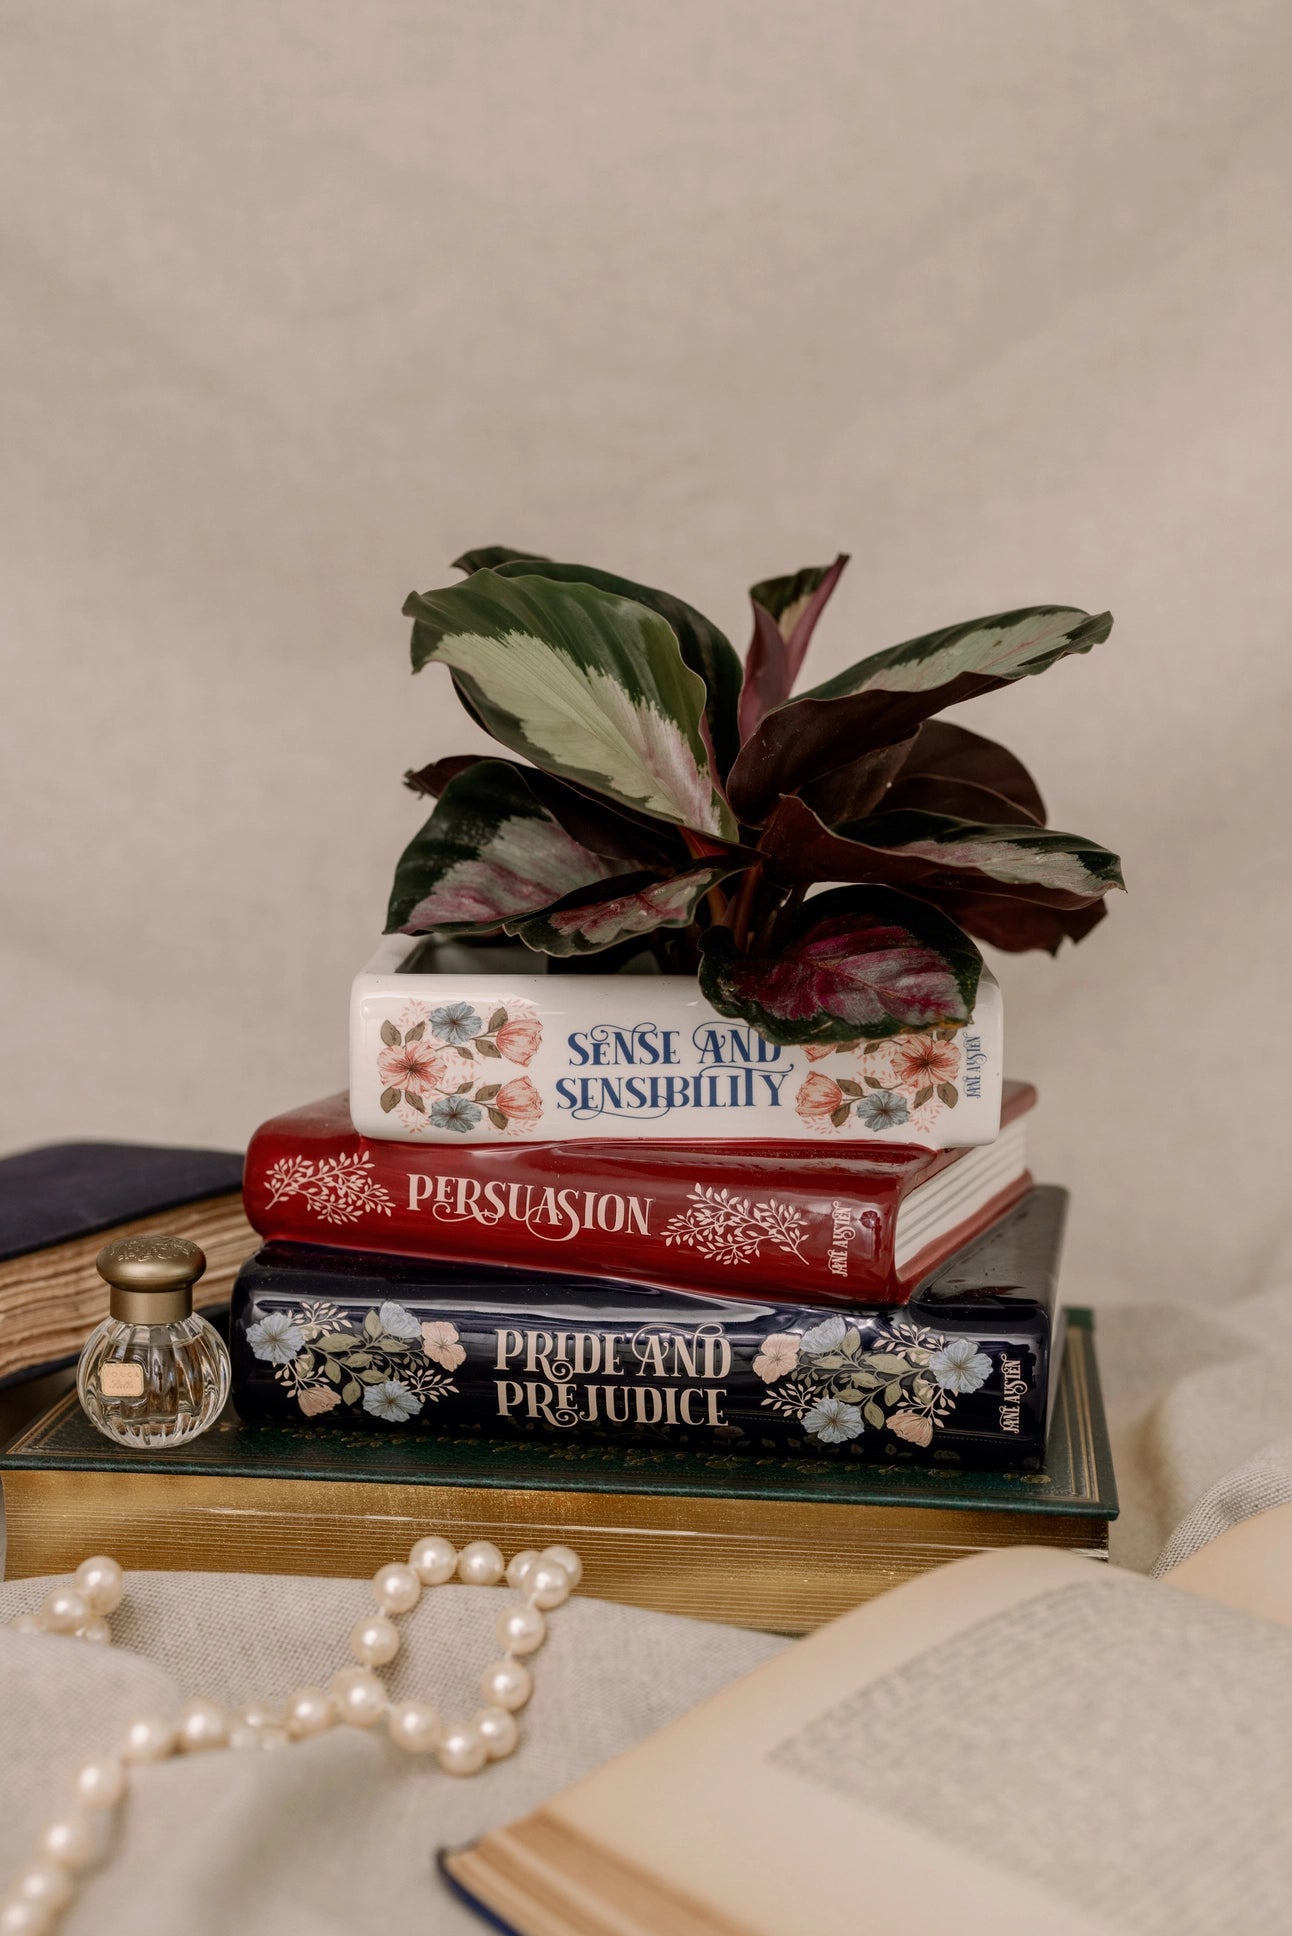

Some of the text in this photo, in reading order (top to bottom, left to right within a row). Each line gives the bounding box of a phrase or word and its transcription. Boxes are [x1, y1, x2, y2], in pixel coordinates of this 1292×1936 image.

[568, 1021, 781, 1066] SENSE AND
[962, 1032, 987, 1099] JANE AUSTEN
[555, 1064, 794, 1120] SENSIBILITY
[406, 1173, 654, 1242] PERSUASION
[827, 1200, 856, 1277] JANE AUSTEN
[493, 1323, 732, 1383] PRIDE AND
[493, 1380, 729, 1428] PREJUDICE
[998, 1353, 1028, 1434] JANE AUSTEN
